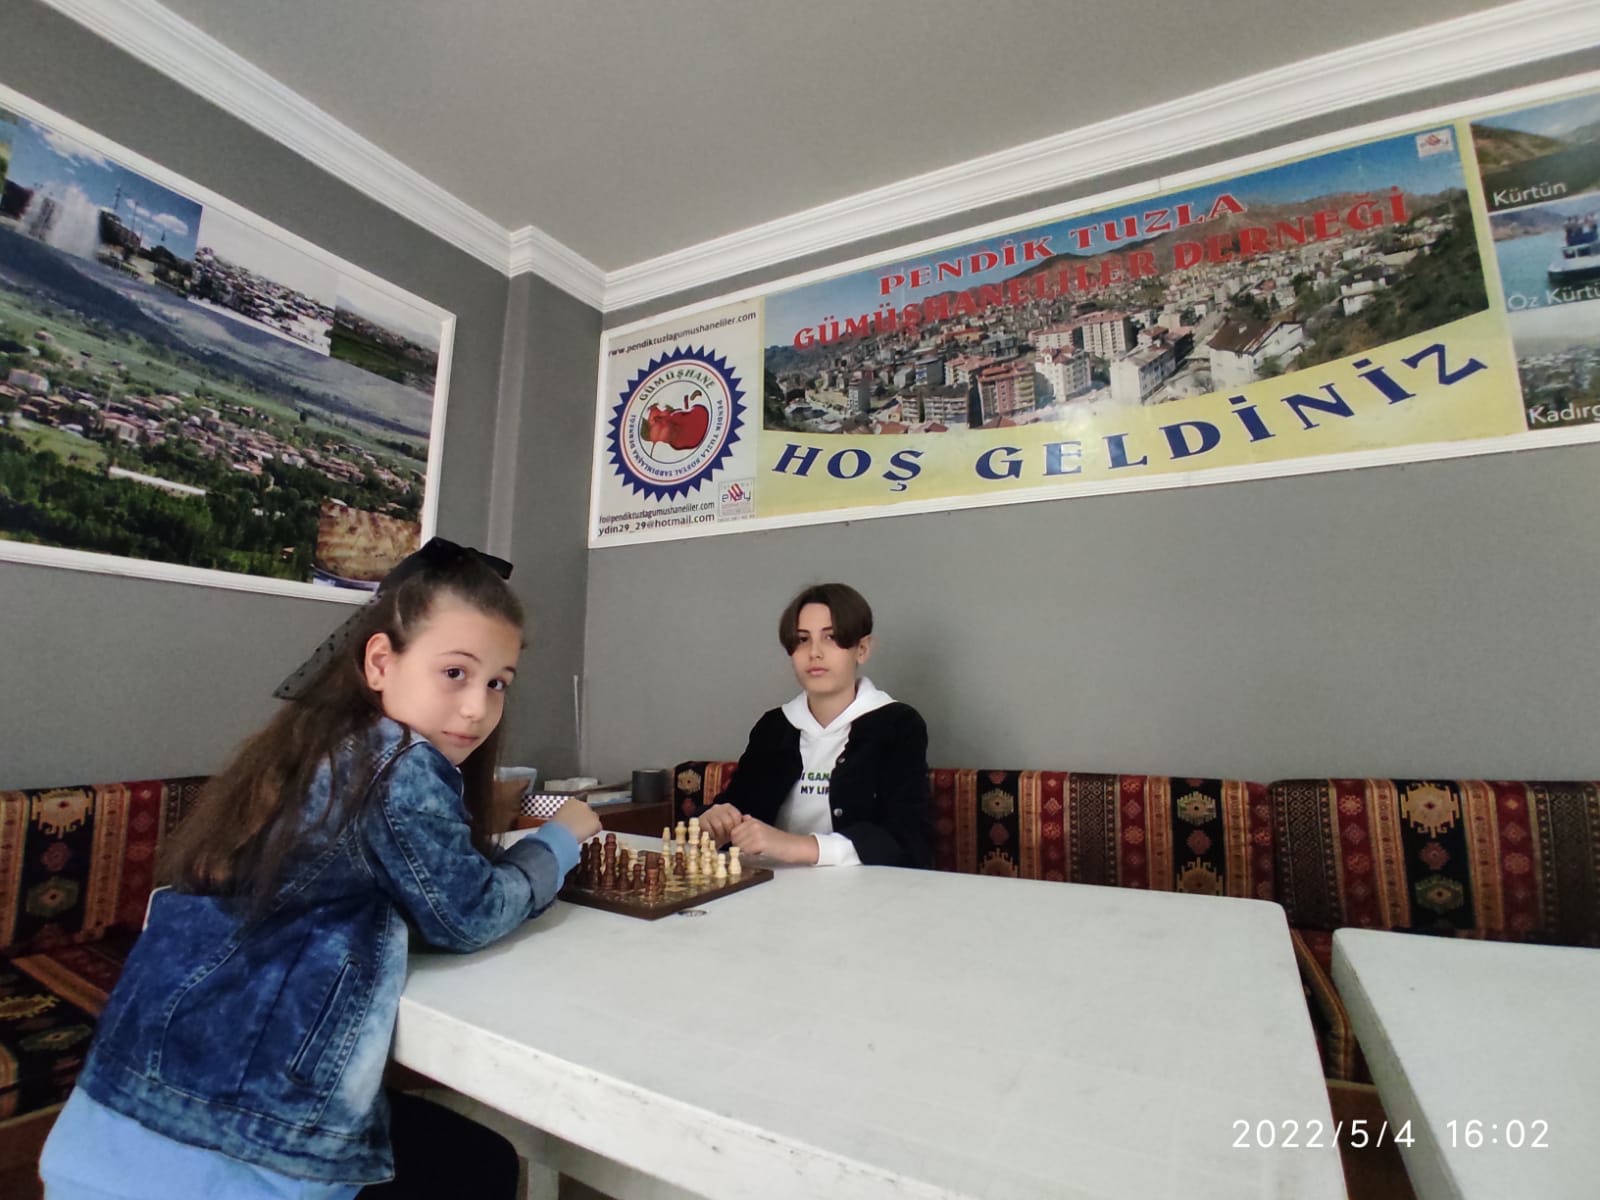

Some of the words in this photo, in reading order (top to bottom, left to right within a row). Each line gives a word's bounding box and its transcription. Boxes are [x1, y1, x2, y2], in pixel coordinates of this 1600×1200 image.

[1174, 185, 1411, 270] DERNEĞİ
[1493, 182, 1567, 207] Kürtün
[879, 237, 1056, 296] PENDİK
[1069, 192, 1248, 249] TUZLA
[771, 443, 924, 492] HOŞ
[975, 343, 1488, 479] GELDİNİZ
[800, 785, 814, 795] MY
